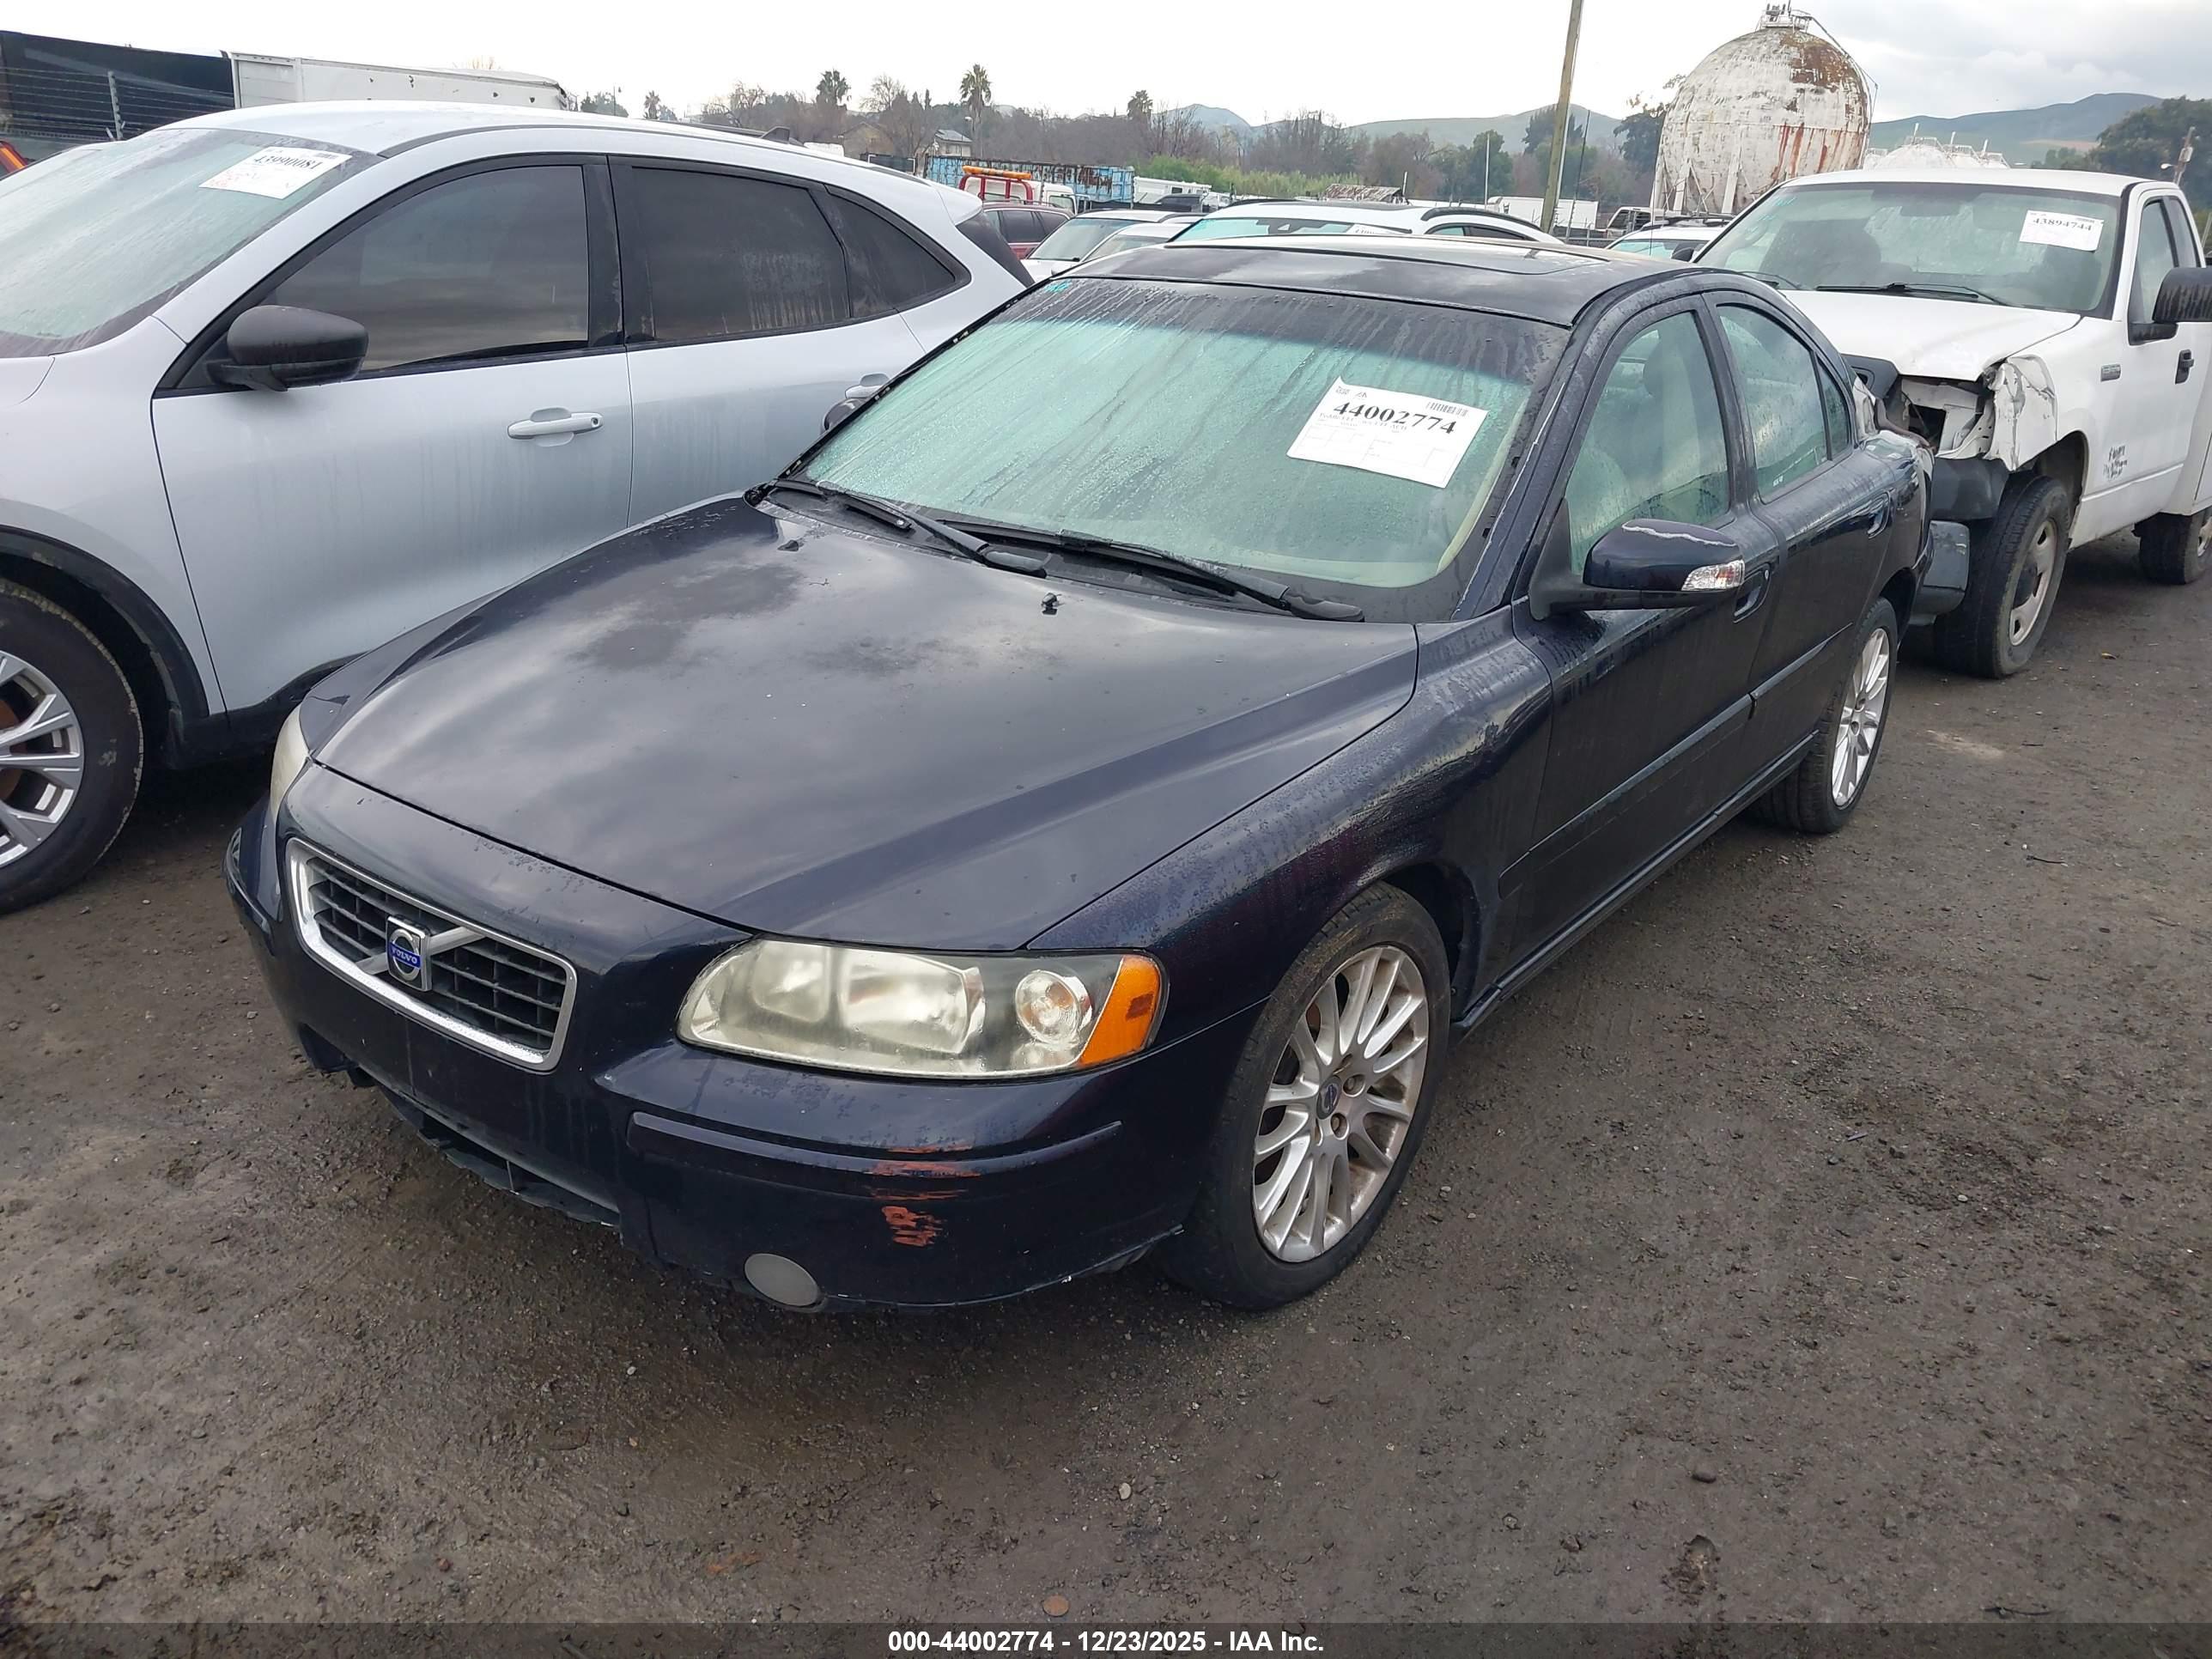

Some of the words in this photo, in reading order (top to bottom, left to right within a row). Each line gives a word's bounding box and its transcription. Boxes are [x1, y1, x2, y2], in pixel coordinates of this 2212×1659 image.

[2033, 217, 2092, 231] 43894744
[1334, 402, 1457, 434] 44002774
[391, 947, 417, 963] VOLVO
